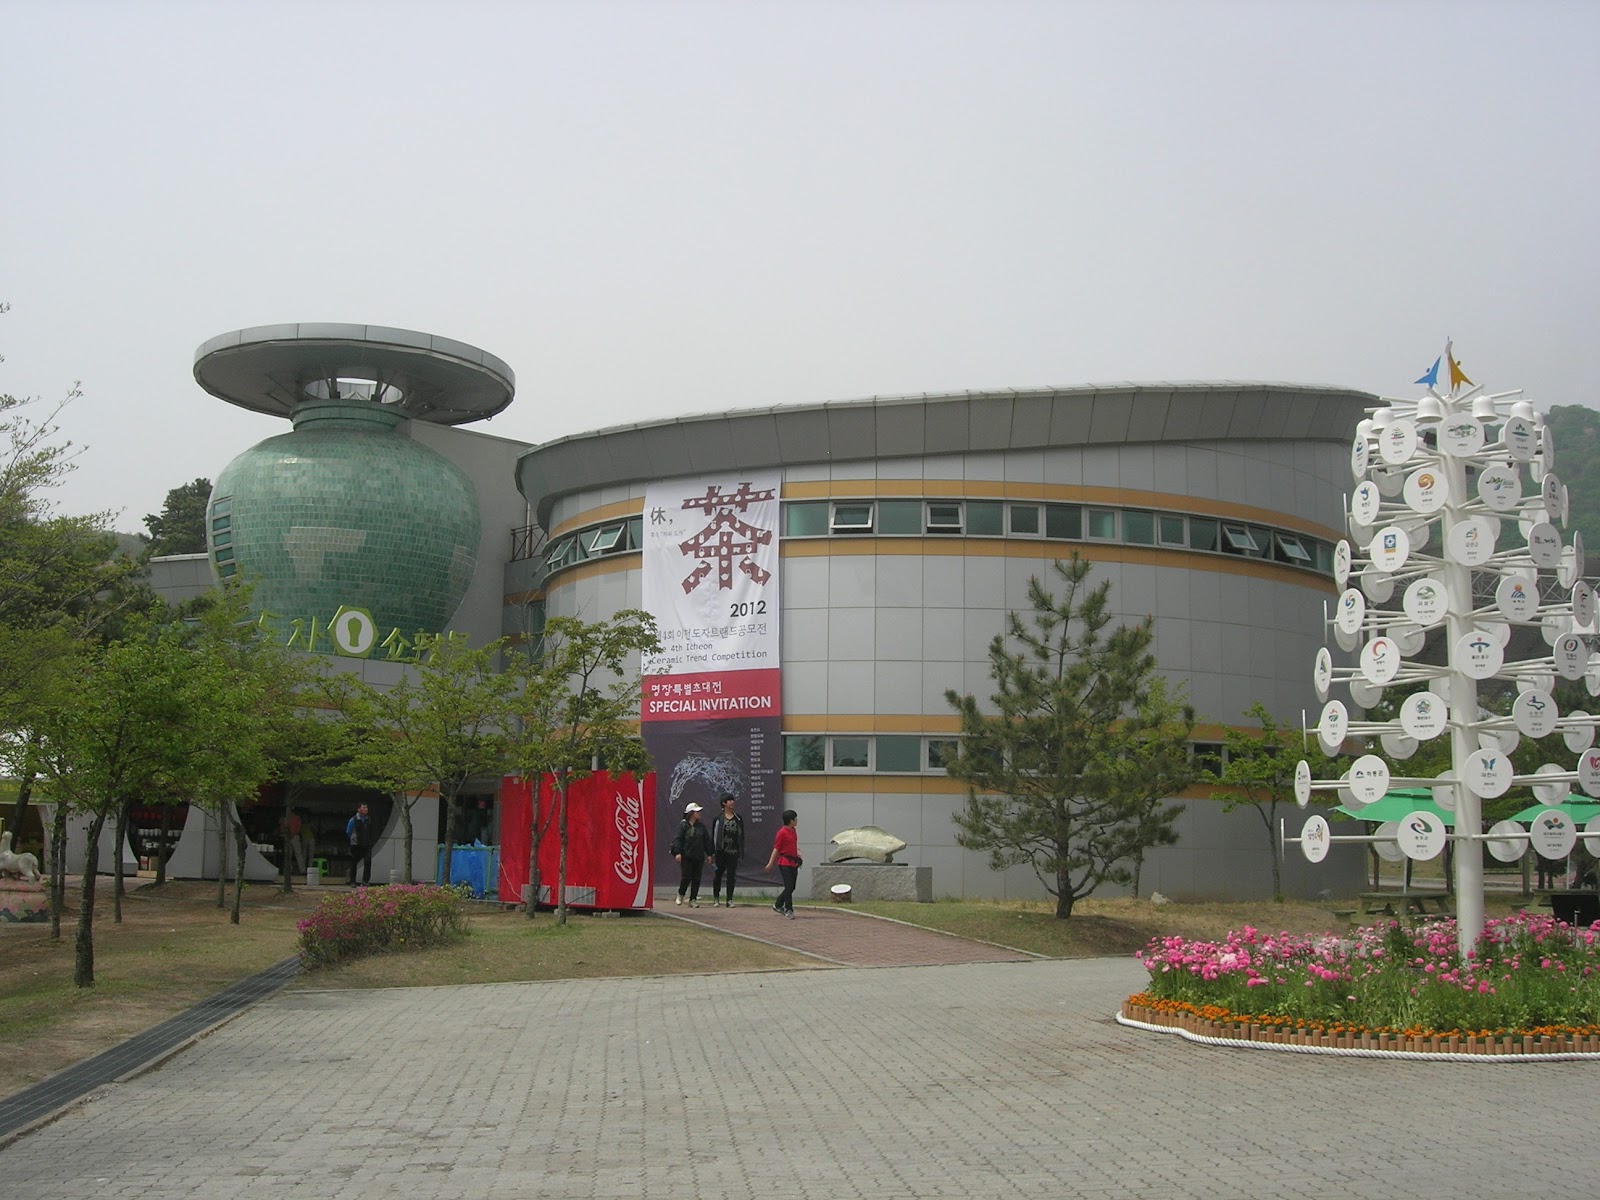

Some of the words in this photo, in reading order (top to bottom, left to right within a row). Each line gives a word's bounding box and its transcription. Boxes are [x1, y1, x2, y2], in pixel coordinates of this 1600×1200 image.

[730, 600, 767, 618] 2012
[670, 643, 683, 652] 4th
[686, 642, 713, 651] Icheon
[651, 656, 683, 665] Ceramic
[686, 654, 708, 663] Trend
[711, 649, 768, 662] Competition
[649, 699, 697, 714] SPECIAL
[699, 695, 772, 712] INVITATION
